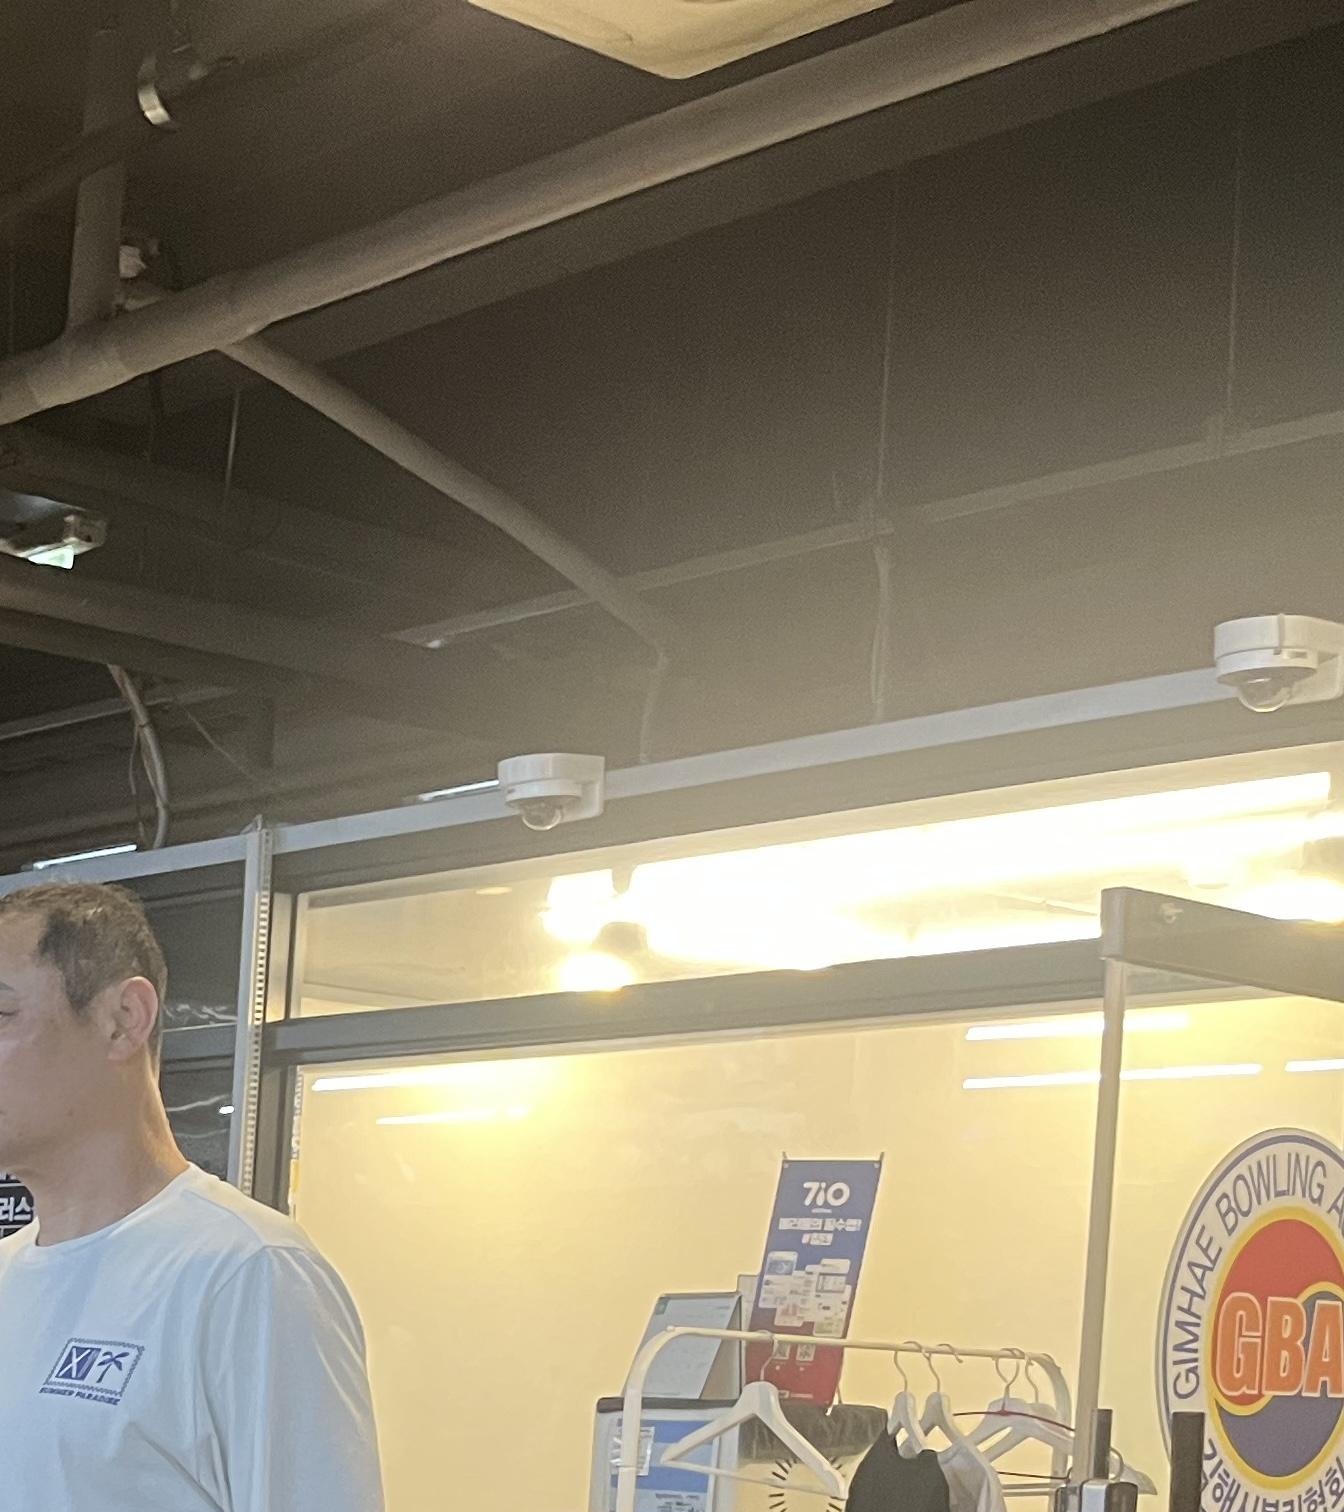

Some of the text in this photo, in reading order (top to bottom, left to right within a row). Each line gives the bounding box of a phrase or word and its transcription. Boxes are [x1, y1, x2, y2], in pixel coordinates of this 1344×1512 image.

[1173, 1224, 1223, 1400] GIMHAE
[1215, 1151, 1327, 1237] BOWLING
[1216, 1291, 1344, 1398] GBA
